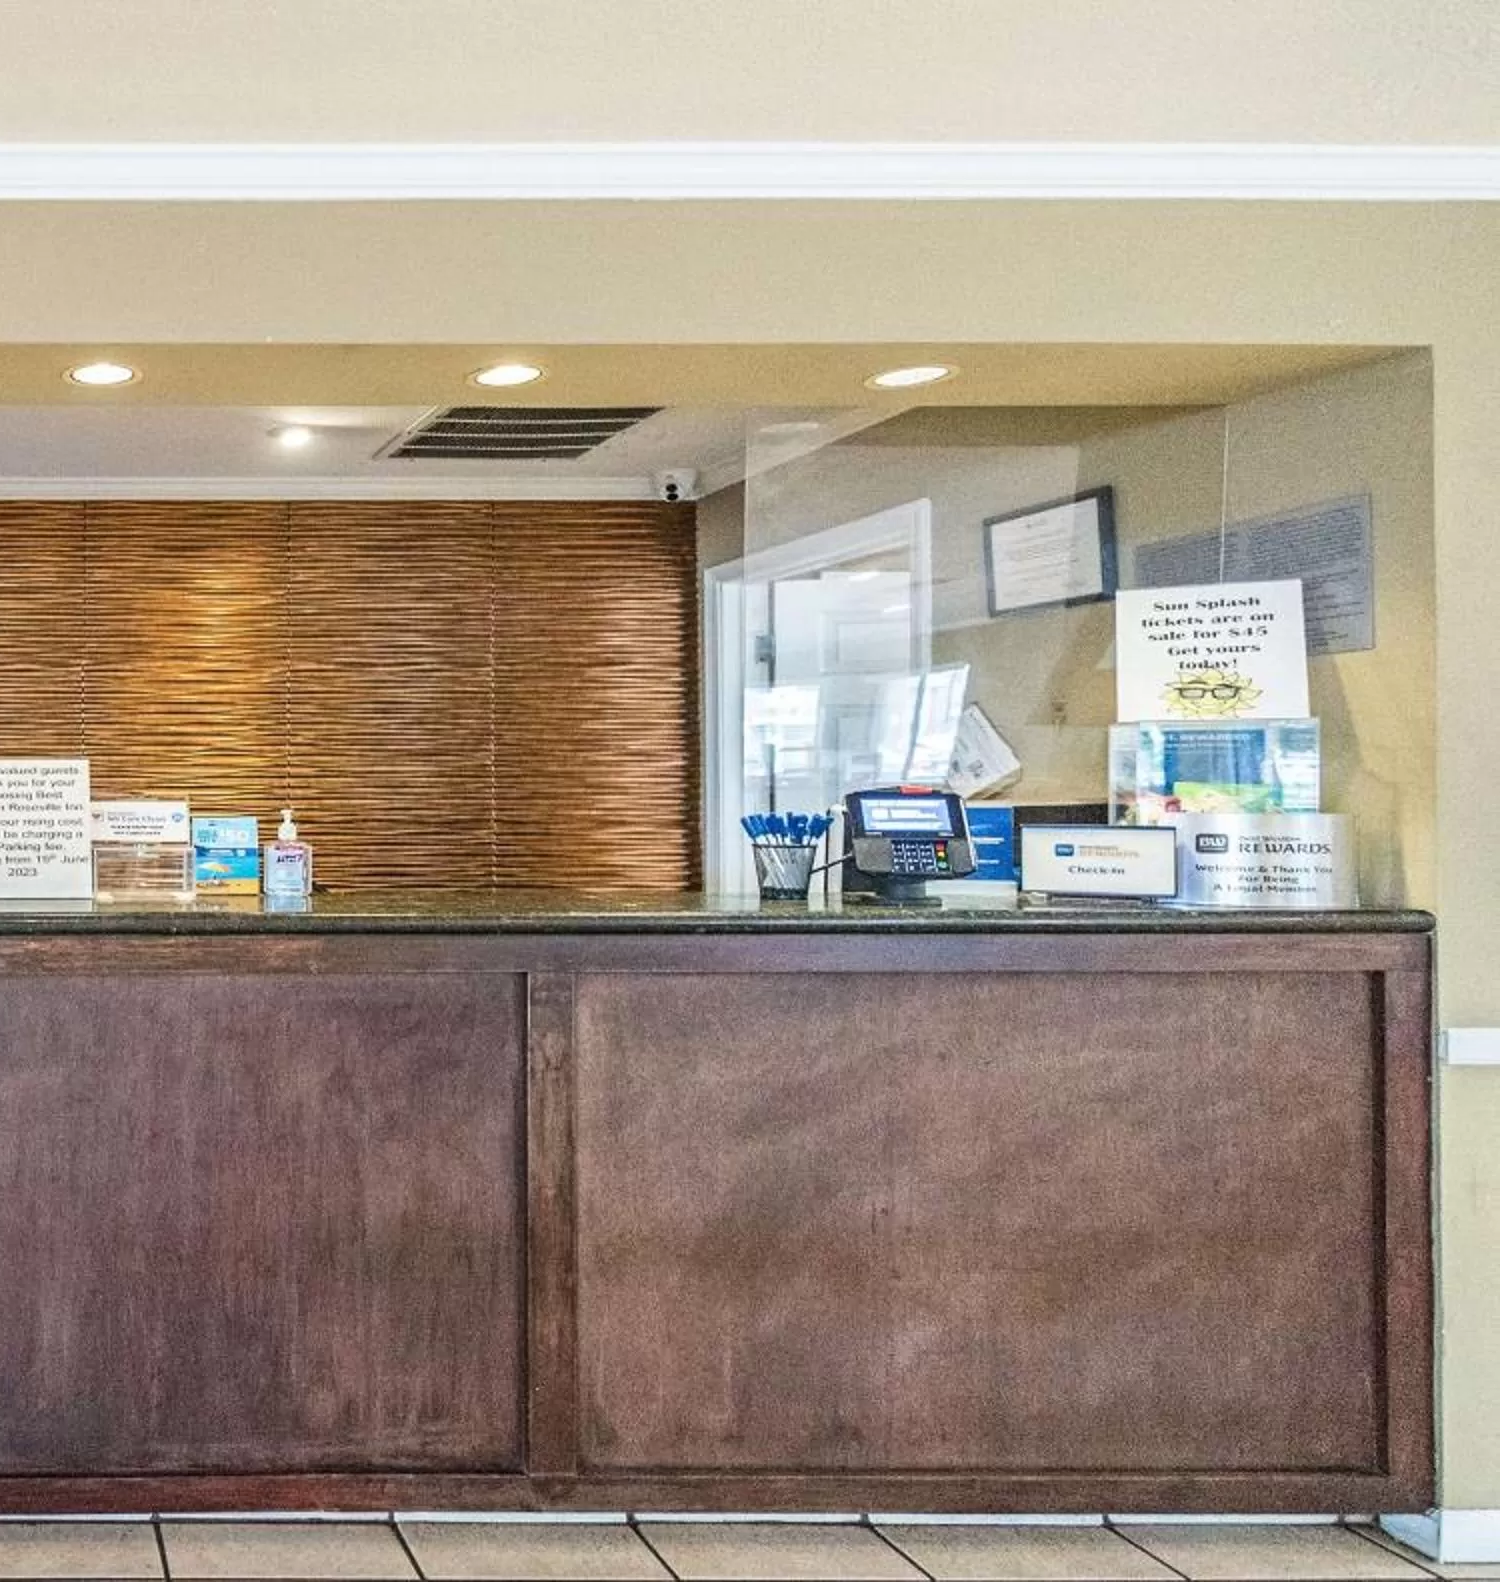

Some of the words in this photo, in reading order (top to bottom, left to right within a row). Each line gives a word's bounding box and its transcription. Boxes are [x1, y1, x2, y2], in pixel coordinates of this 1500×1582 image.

[1153, 602, 1189, 612] Sun
[1195, 597, 1262, 611] Splash
[1141, 617, 1204, 628] tickets
[1210, 615, 1243, 624] are
[1249, 613, 1275, 622] on
[1148, 631, 1187, 641] sale
[1193, 630, 1222, 639] for
[1228, 626, 1269, 637] $45
[1167, 646, 1200, 656] Get
[1205, 644, 1262, 655] yours
[1178, 658, 1238, 670] today!
[0, 766, 38, 775] valued
[7, 780, 29, 789] you
[31, 778, 47, 787] for
[49, 779, 76, 788] your
[35, 791, 64, 799] Best
[0, 819, 20, 827] our
[22, 818, 55, 828] rising
[3, 830, 19, 839] be
[21, 830, 73, 841] charging
[1238, 843, 1332, 855] REWARDS
[4, 855, 33, 864] from
[59, 855, 90, 864] June
[7, 866, 39, 878] 2023
